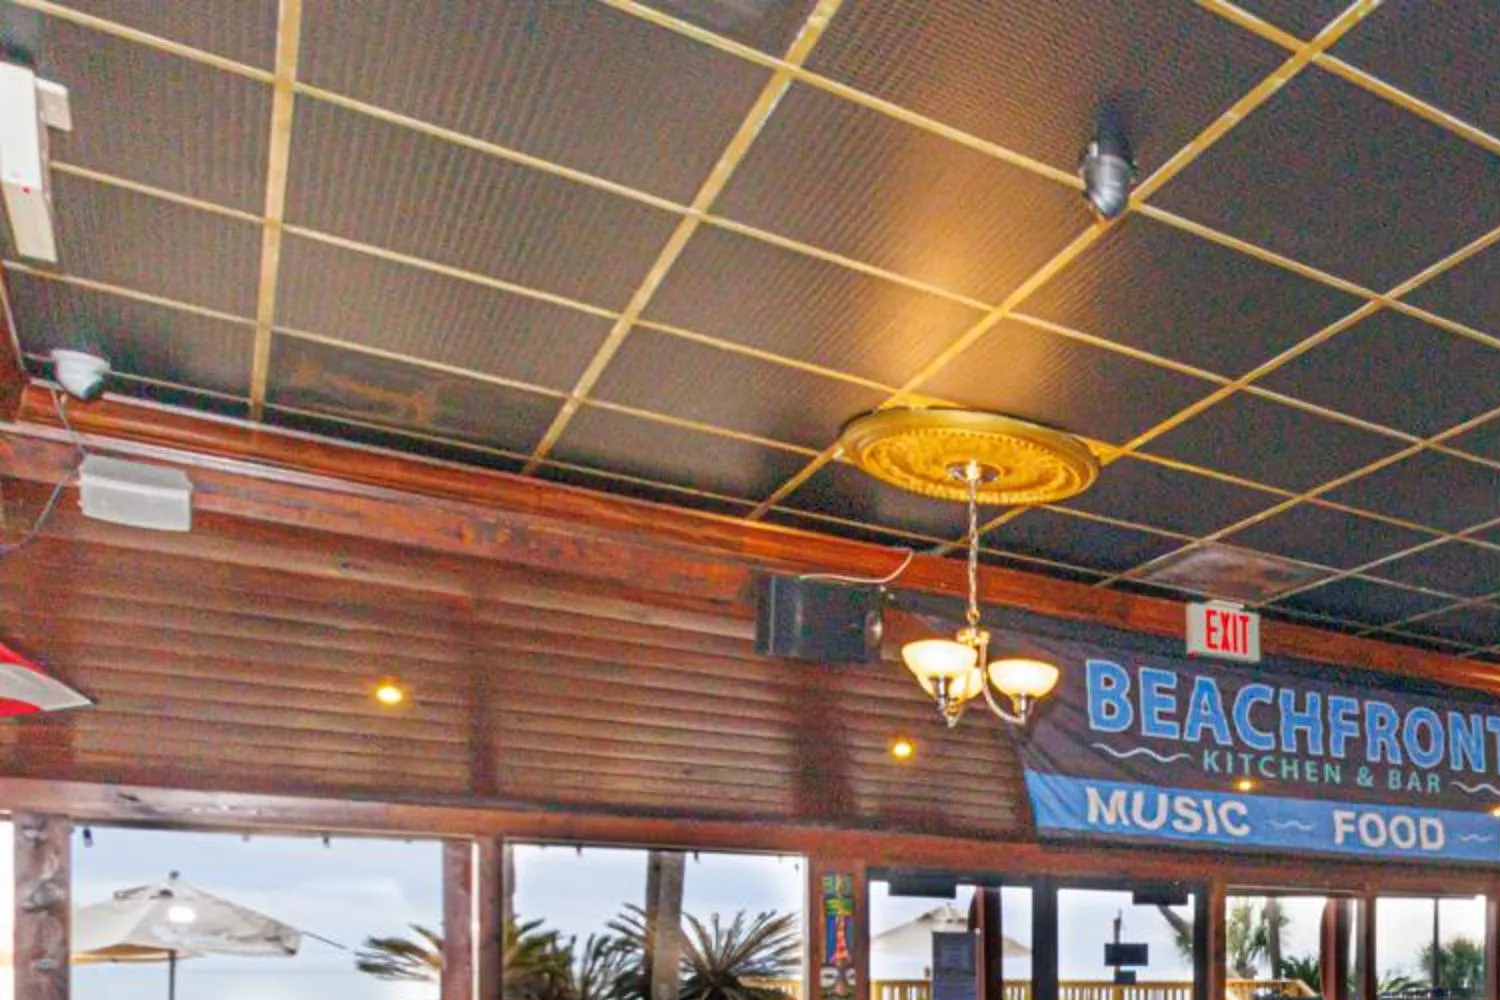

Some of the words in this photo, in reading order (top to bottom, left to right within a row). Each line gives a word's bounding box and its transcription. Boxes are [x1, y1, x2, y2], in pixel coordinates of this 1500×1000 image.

[1205, 609, 1250, 655] EXIT
[1203, 750, 1341, 784] KITCHEN
[1356, 766, 1374, 788] &
[1388, 770, 1441, 793] BAR
[1086, 786, 1250, 837] MUSIC
[1333, 810, 1445, 850] FOOD
